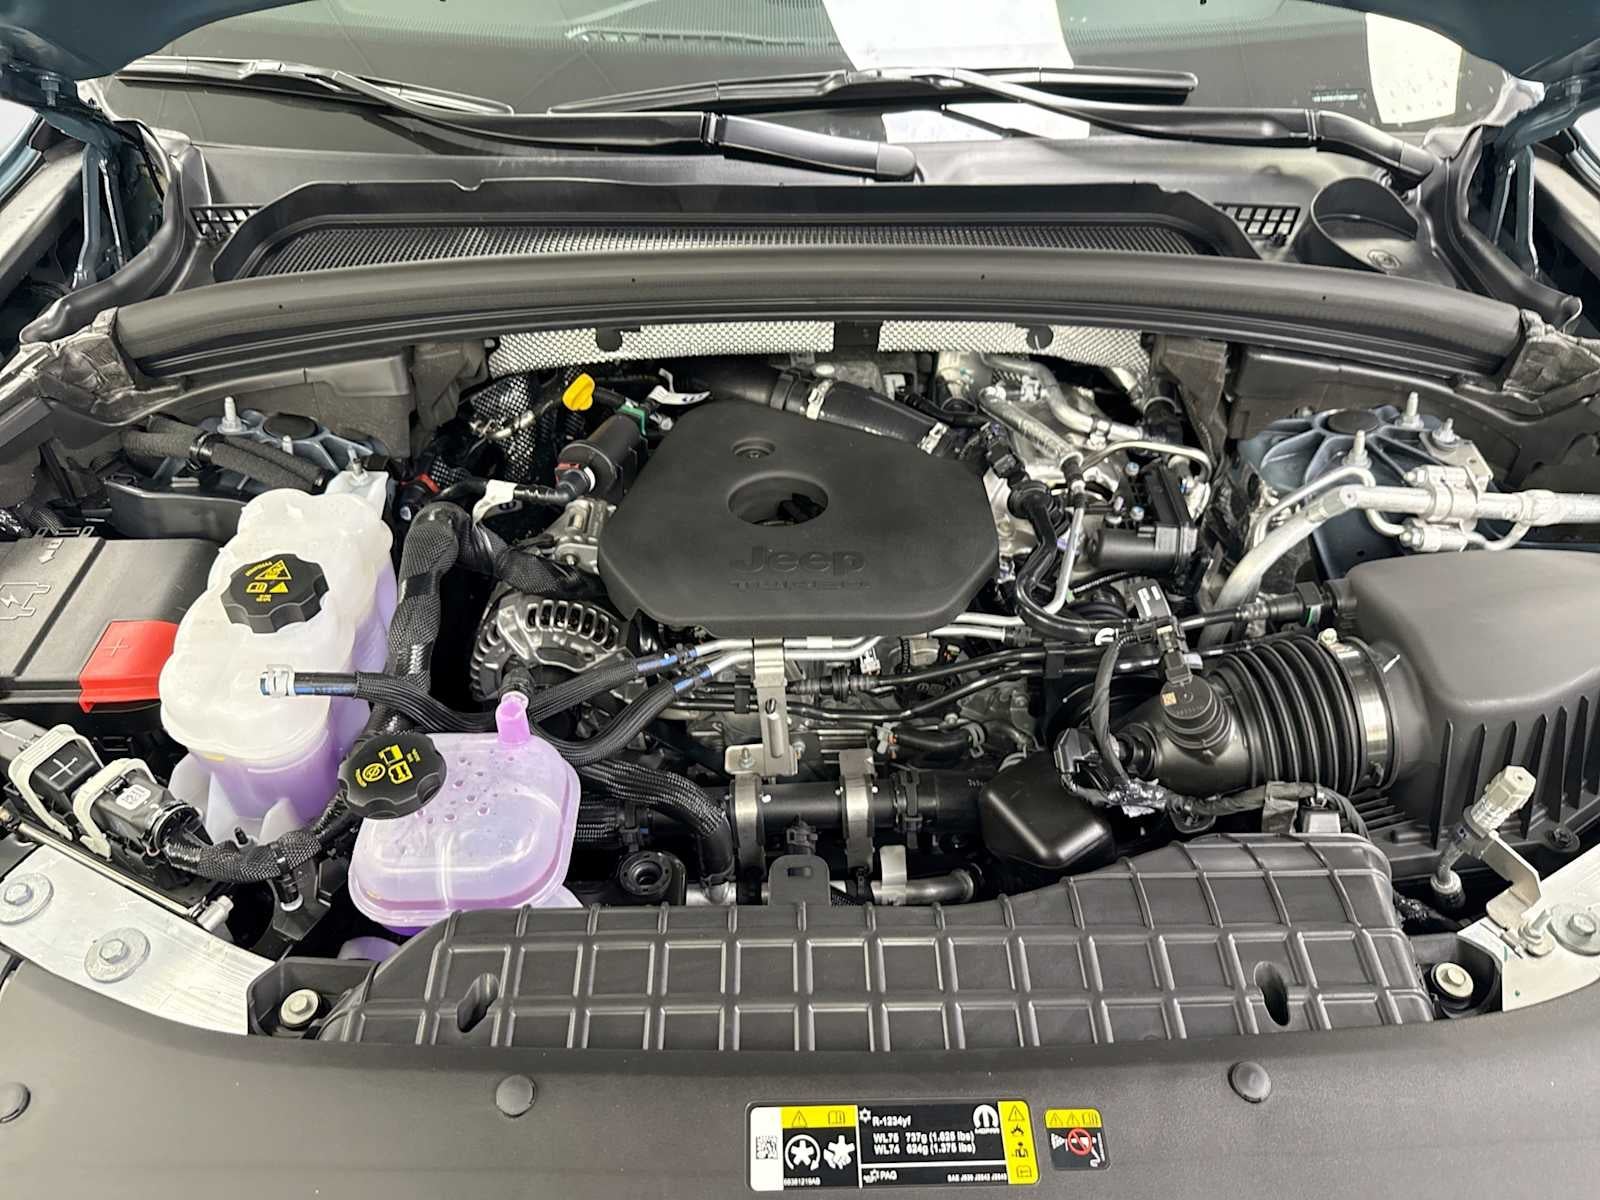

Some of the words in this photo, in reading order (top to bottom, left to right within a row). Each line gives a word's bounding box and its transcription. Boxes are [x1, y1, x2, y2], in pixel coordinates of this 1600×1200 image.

[729, 545, 867, 576] Jeep
[872, 1115, 911, 1128] R-1234yf
[905, 1132, 928, 1145] 737g
[957, 1130, 975, 1143] lbs)
[958, 1142, 977, 1155] lbs)
